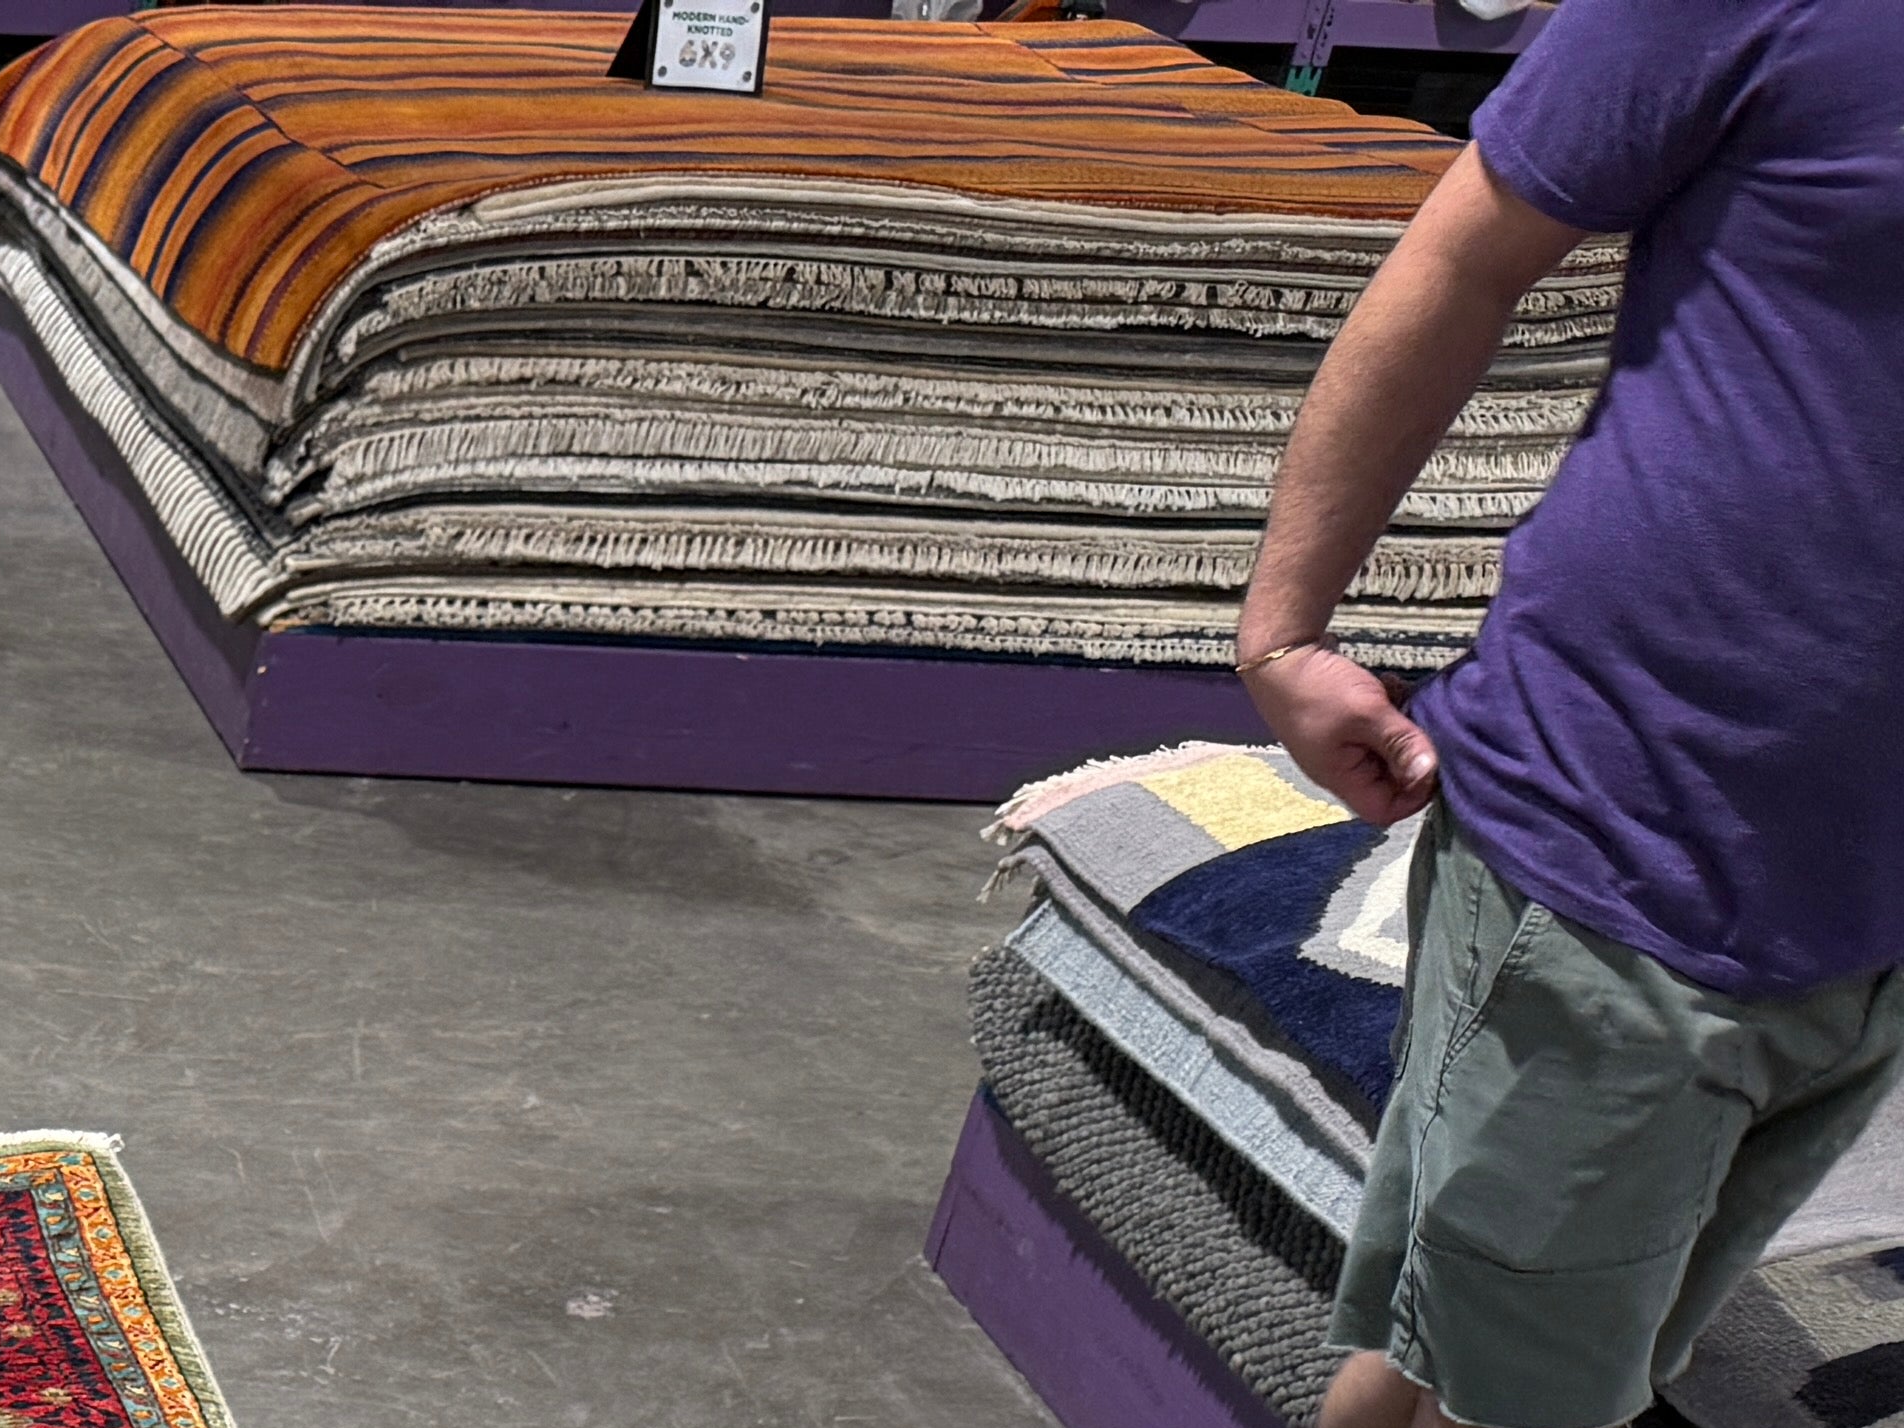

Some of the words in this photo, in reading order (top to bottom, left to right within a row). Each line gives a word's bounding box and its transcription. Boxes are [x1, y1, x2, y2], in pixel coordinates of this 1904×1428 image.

[672, 11, 716, 22] MODERN
[718, 15, 749, 25] HAND-
[687, 25, 734, 36] KNOTTED
[679, 39, 736, 70] 6X9
